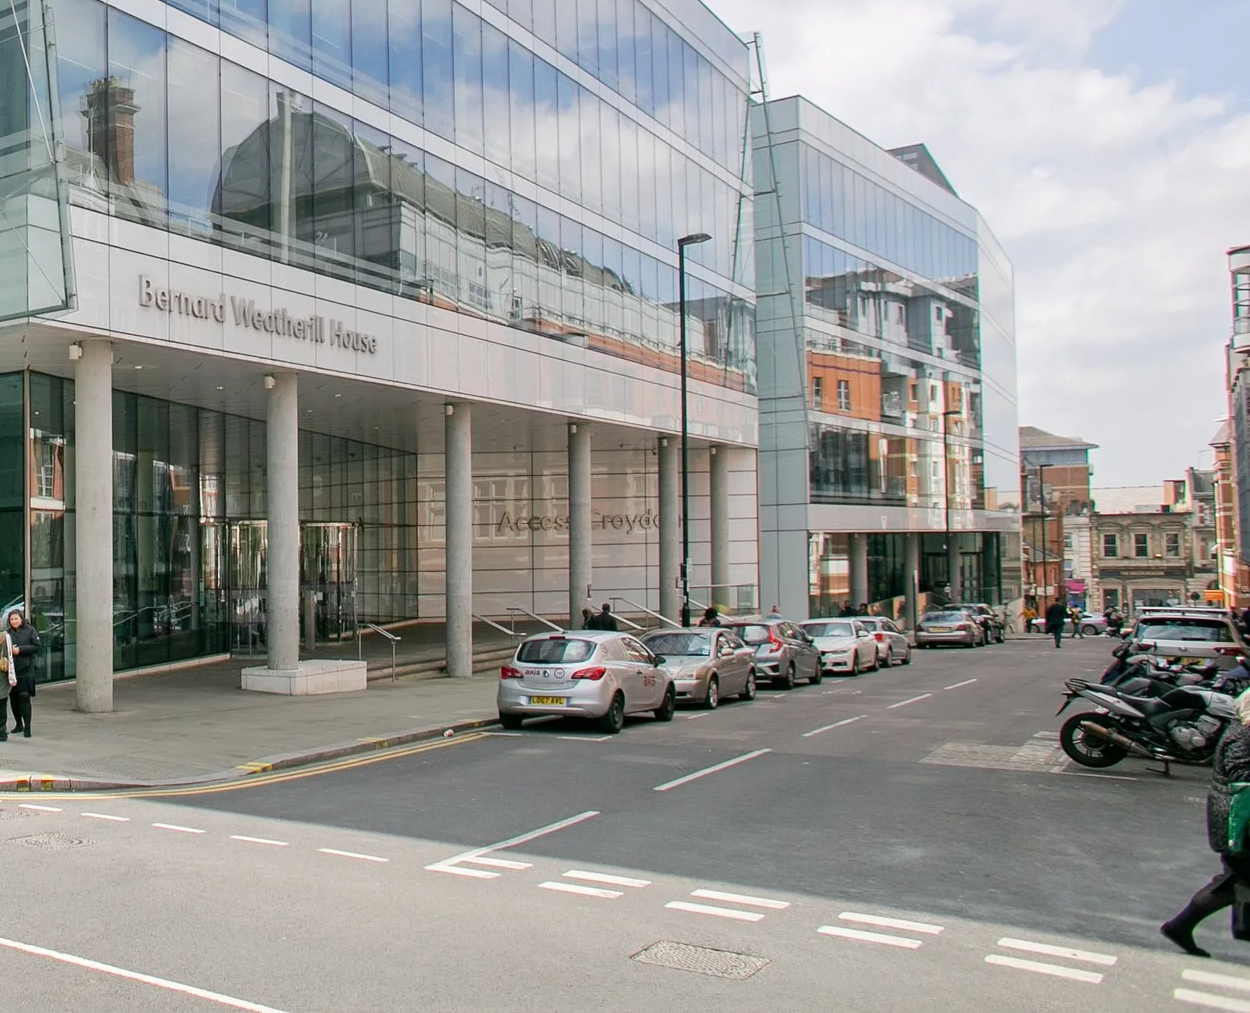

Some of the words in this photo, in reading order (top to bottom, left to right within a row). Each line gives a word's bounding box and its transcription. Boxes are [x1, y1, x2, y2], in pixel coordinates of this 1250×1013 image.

[138, 274, 227, 324] Bernard
[230, 295, 325, 344] Weatherill
[329, 319, 378, 355] House
[591, 508, 682, 535] Croydo
[525, 668, 541, 676] axis
